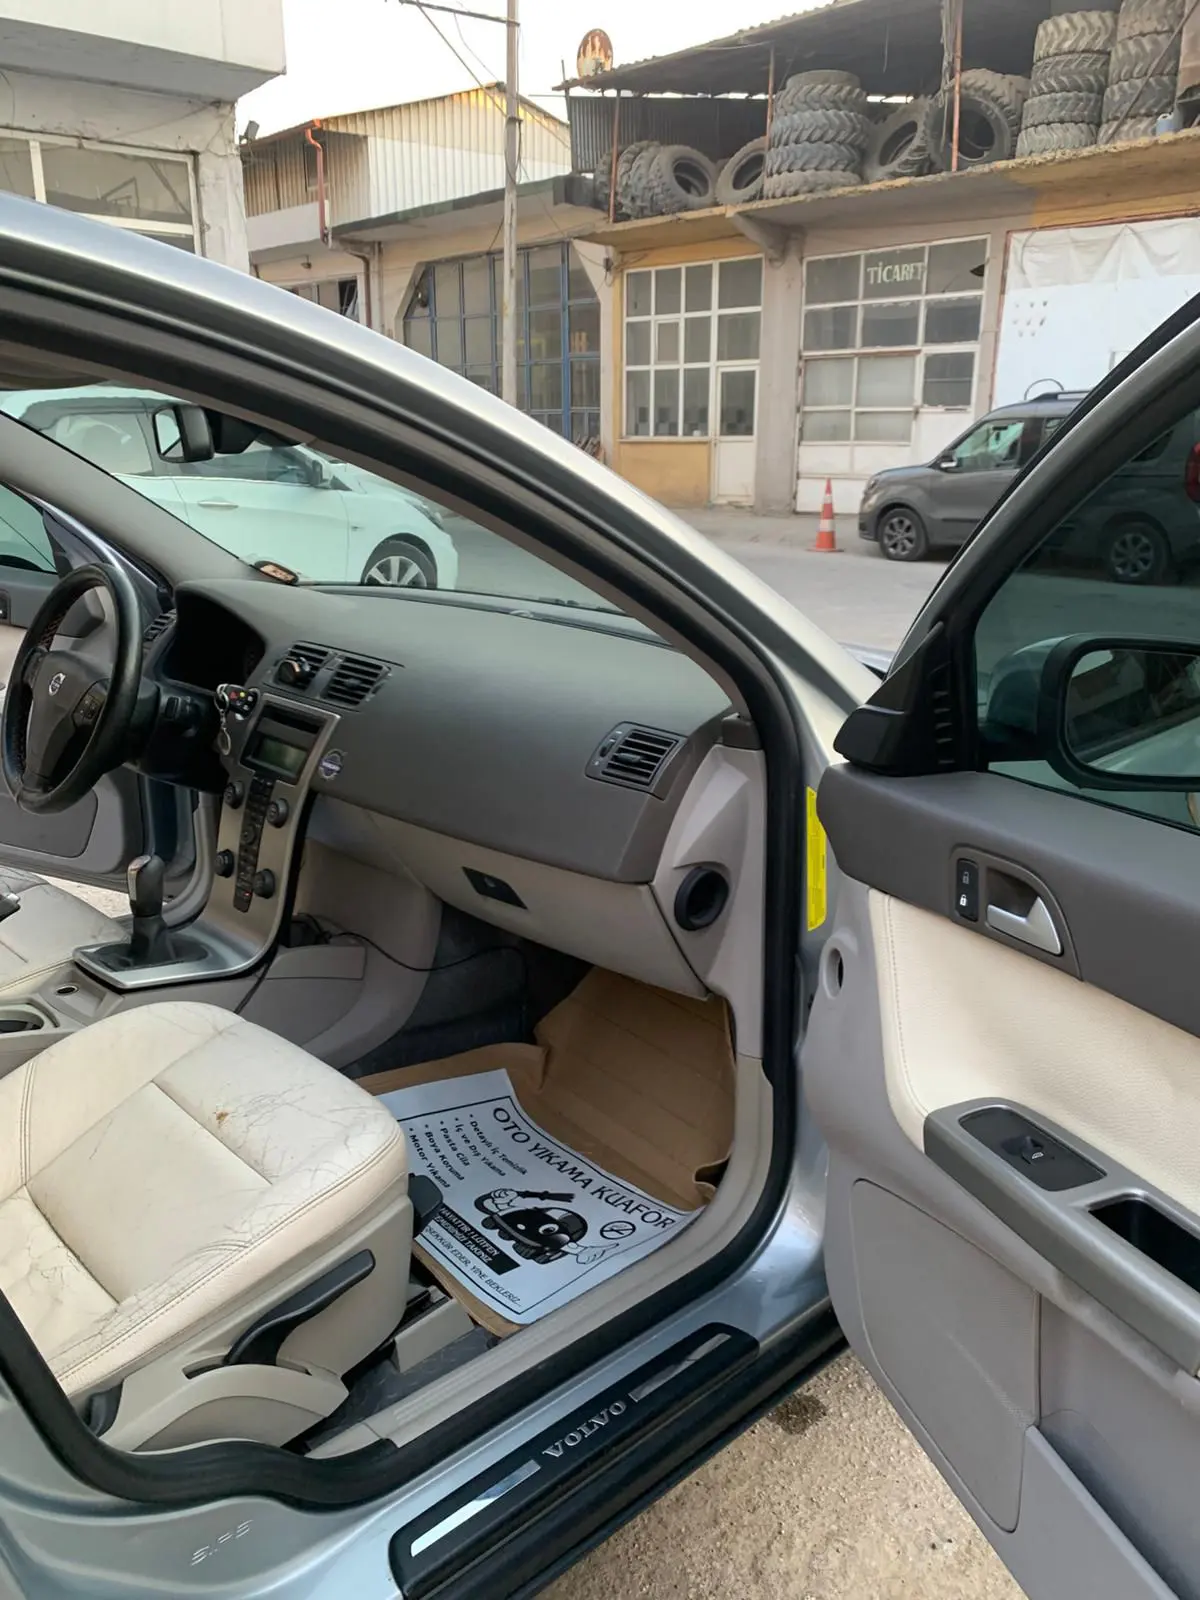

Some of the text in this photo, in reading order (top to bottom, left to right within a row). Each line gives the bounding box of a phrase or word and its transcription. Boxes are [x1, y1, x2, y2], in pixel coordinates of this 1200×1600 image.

[866, 261, 925, 284] TİCARET
[410, 1134, 451, 1188] Motor Yıkama
[425, 1131, 465, 1180] Boya Koruma
[440, 1127, 470, 1167] Pasta Cila
[461, 1133, 470, 1144] ve
[469, 1144, 481, 1157] Dış
[481, 1157, 506, 1176] Yıkama
[470, 1120, 493, 1148] Detaylı
[498, 1153, 528, 1175] Temizlik
[493, 1107, 676, 1228] OTO YIKAMA KUAFÖR
[542, 1401, 626, 1457] VOLVO
